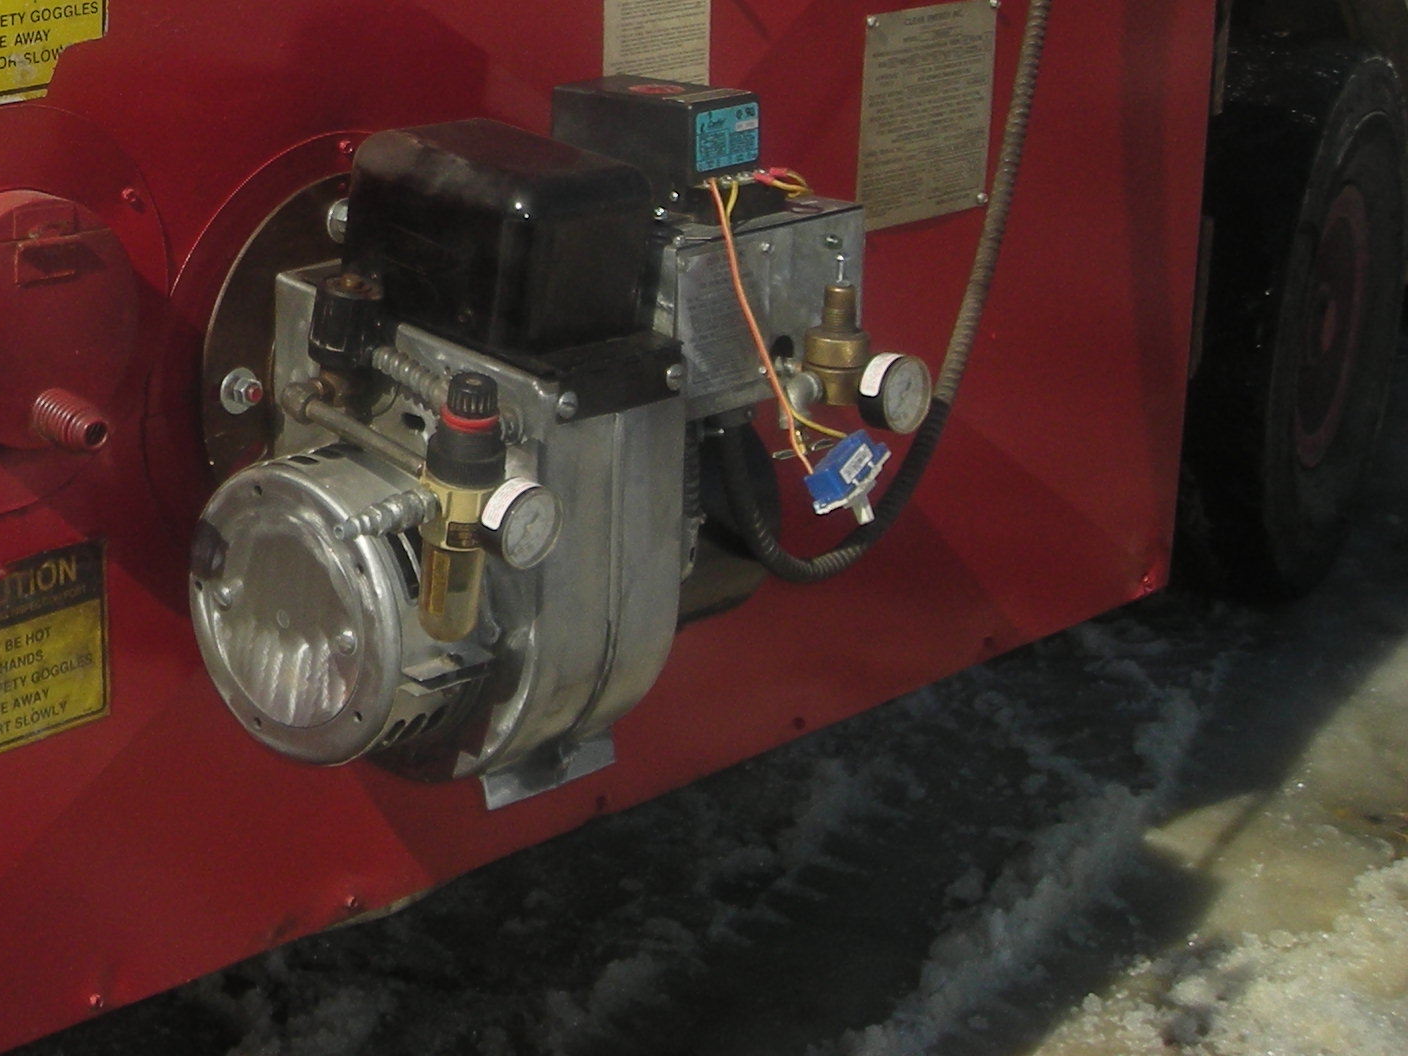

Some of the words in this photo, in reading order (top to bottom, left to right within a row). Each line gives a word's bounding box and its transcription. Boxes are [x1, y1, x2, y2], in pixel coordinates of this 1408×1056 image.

[31, 1, 98, 23] GOGGLES
[14, 29, 50, 46] AWAY
[5, 637, 22, 652] BE
[25, 626, 51, 646] HOT
[0, 650, 44, 675] HANDS
[31, 653, 94, 684] GOGGLES
[13, 688, 50, 710] AWAY
[15, 700, 68, 729] SLOWLY
